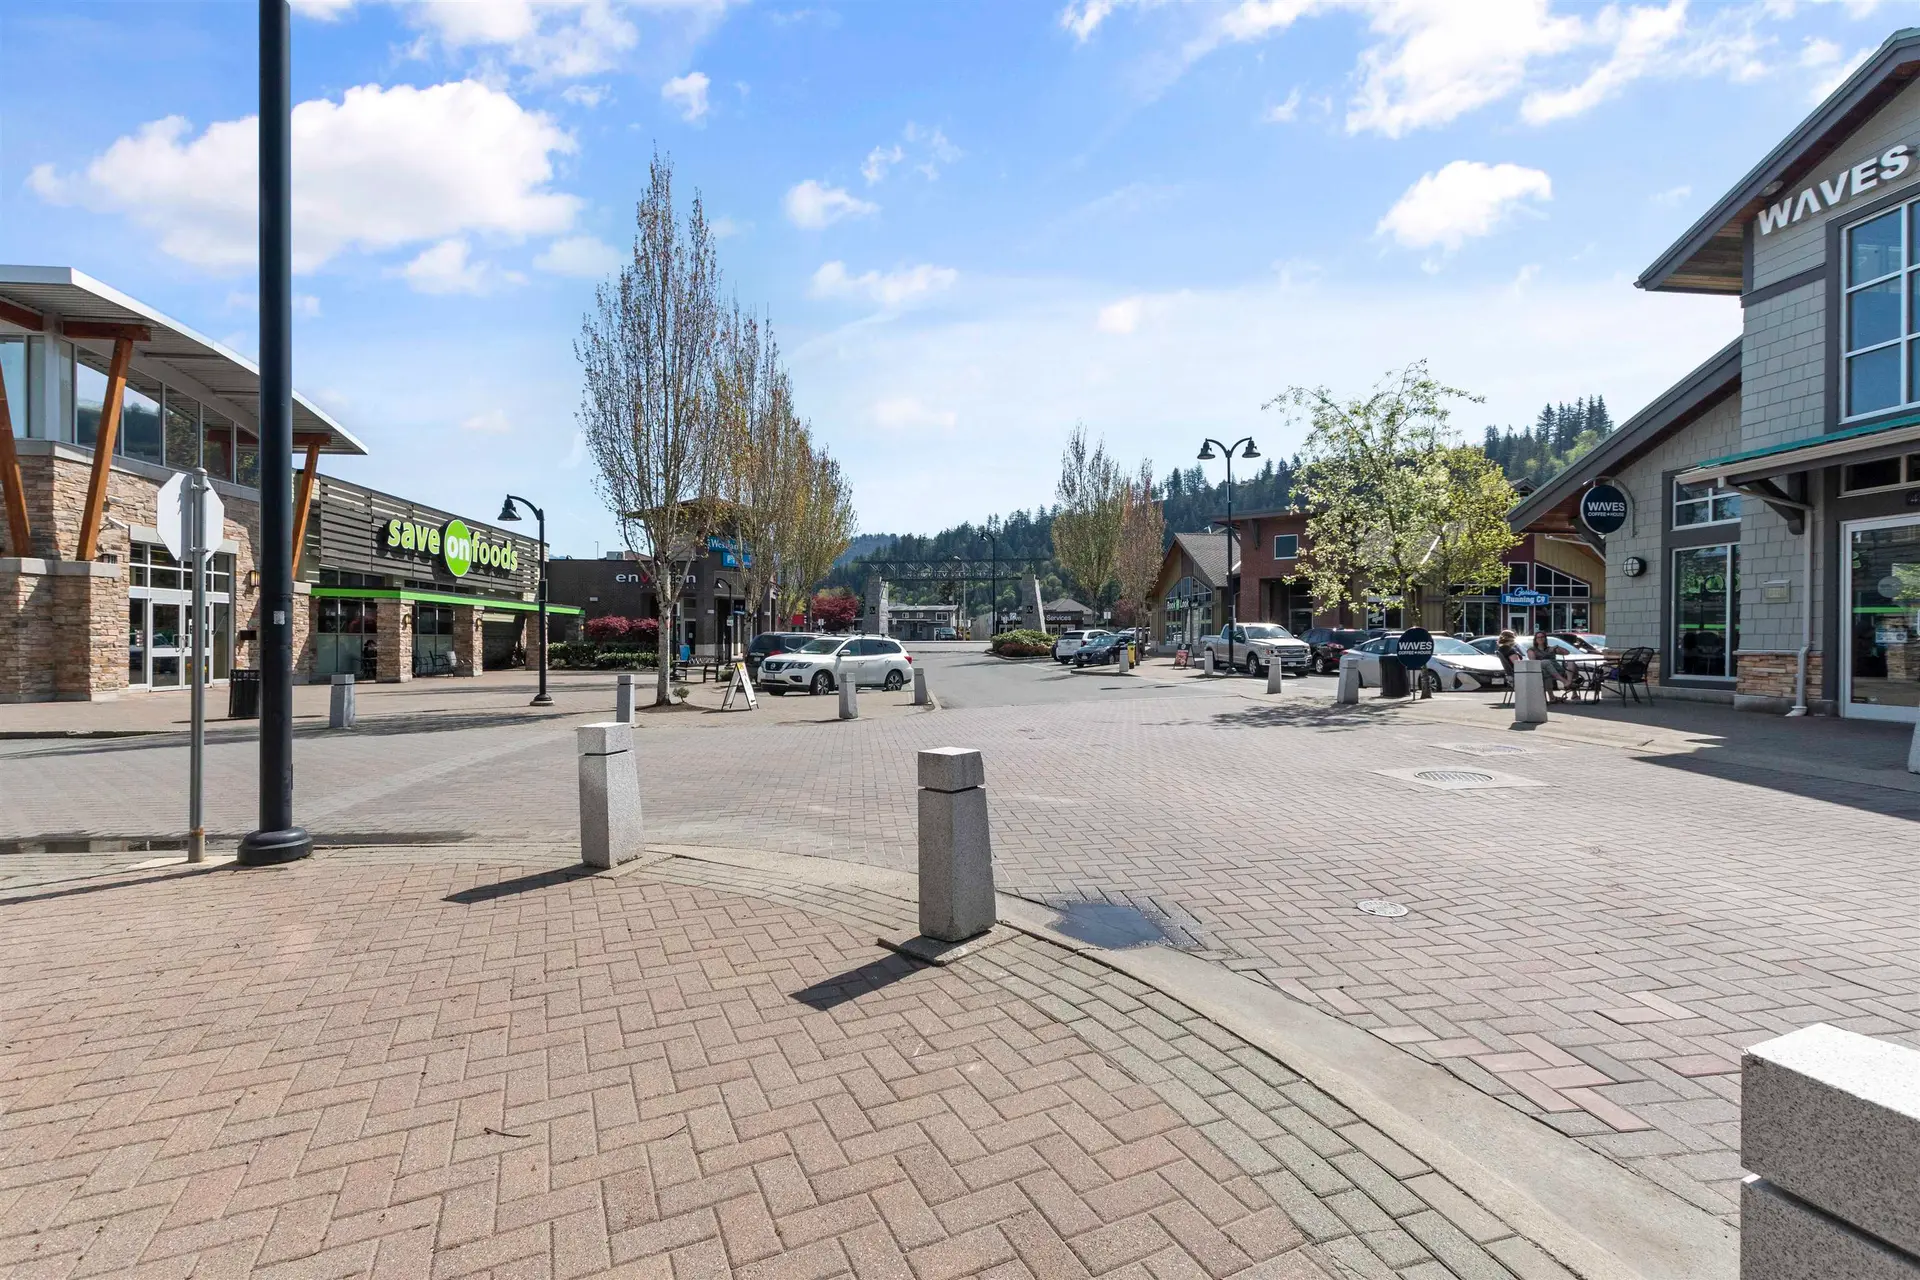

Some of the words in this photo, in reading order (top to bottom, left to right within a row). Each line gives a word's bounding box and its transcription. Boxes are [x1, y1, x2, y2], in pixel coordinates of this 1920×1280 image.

[1757, 144, 1909, 236] WAVES
[1587, 501, 1625, 511] WAVES
[387, 519, 441, 555] save
[446, 535, 470, 562] on
[470, 531, 518, 572] foods
[1505, 595, 1535, 604] Running
[1046, 613, 1072, 621] Services
[1398, 641, 1433, 650] WAVES
